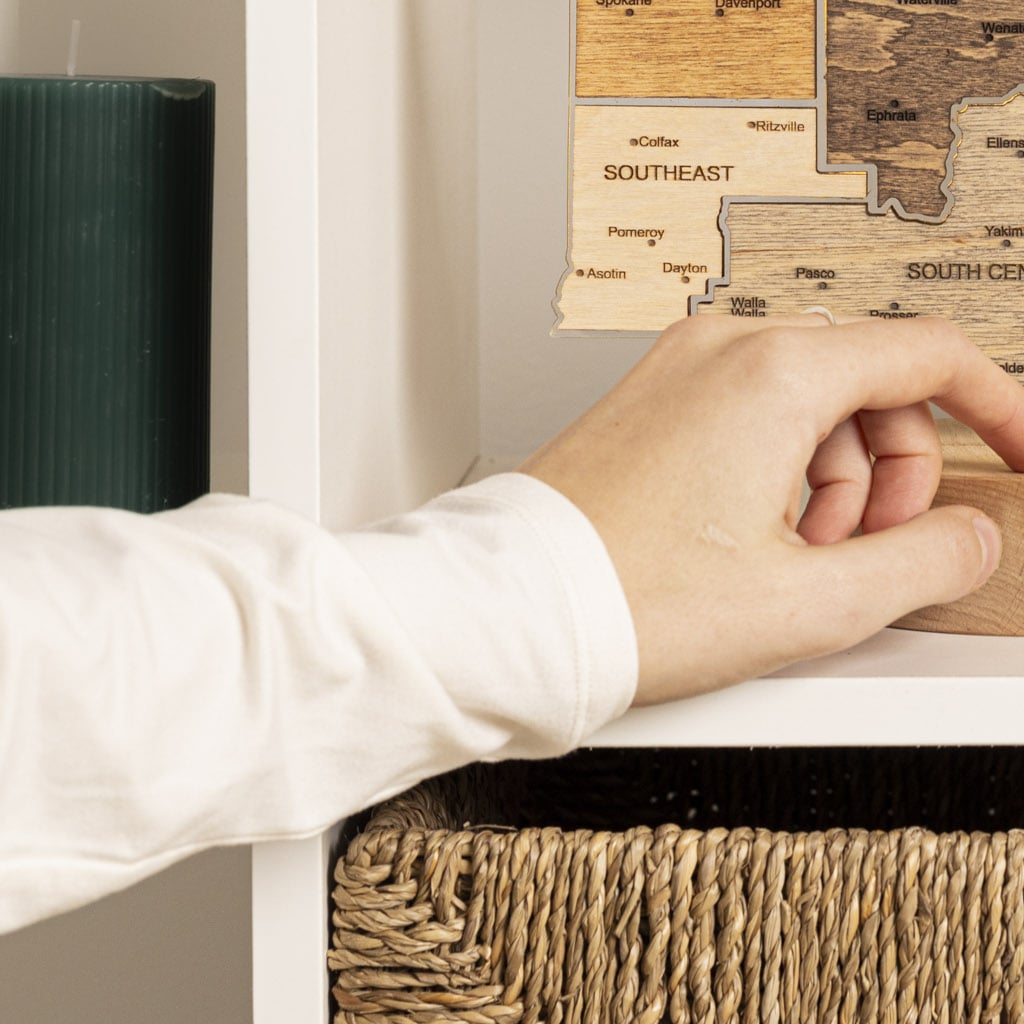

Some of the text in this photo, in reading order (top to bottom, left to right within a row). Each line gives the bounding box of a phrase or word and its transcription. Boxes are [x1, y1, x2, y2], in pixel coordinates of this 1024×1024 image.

[866, 109, 916, 123] Ephrata
[756, 120, 805, 132] Ritzville
[639, 136, 679, 147] Colfax
[604, 164, 735, 182] SOUTHEAST
[608, 226, 665, 240] Pomeroy
[587, 268, 626, 280] Asotin
[663, 262, 708, 275] Dayton
[796, 268, 835, 279] Pasco
[907, 263, 981, 280] SOUTH
[731, 296, 766, 308] Walla
